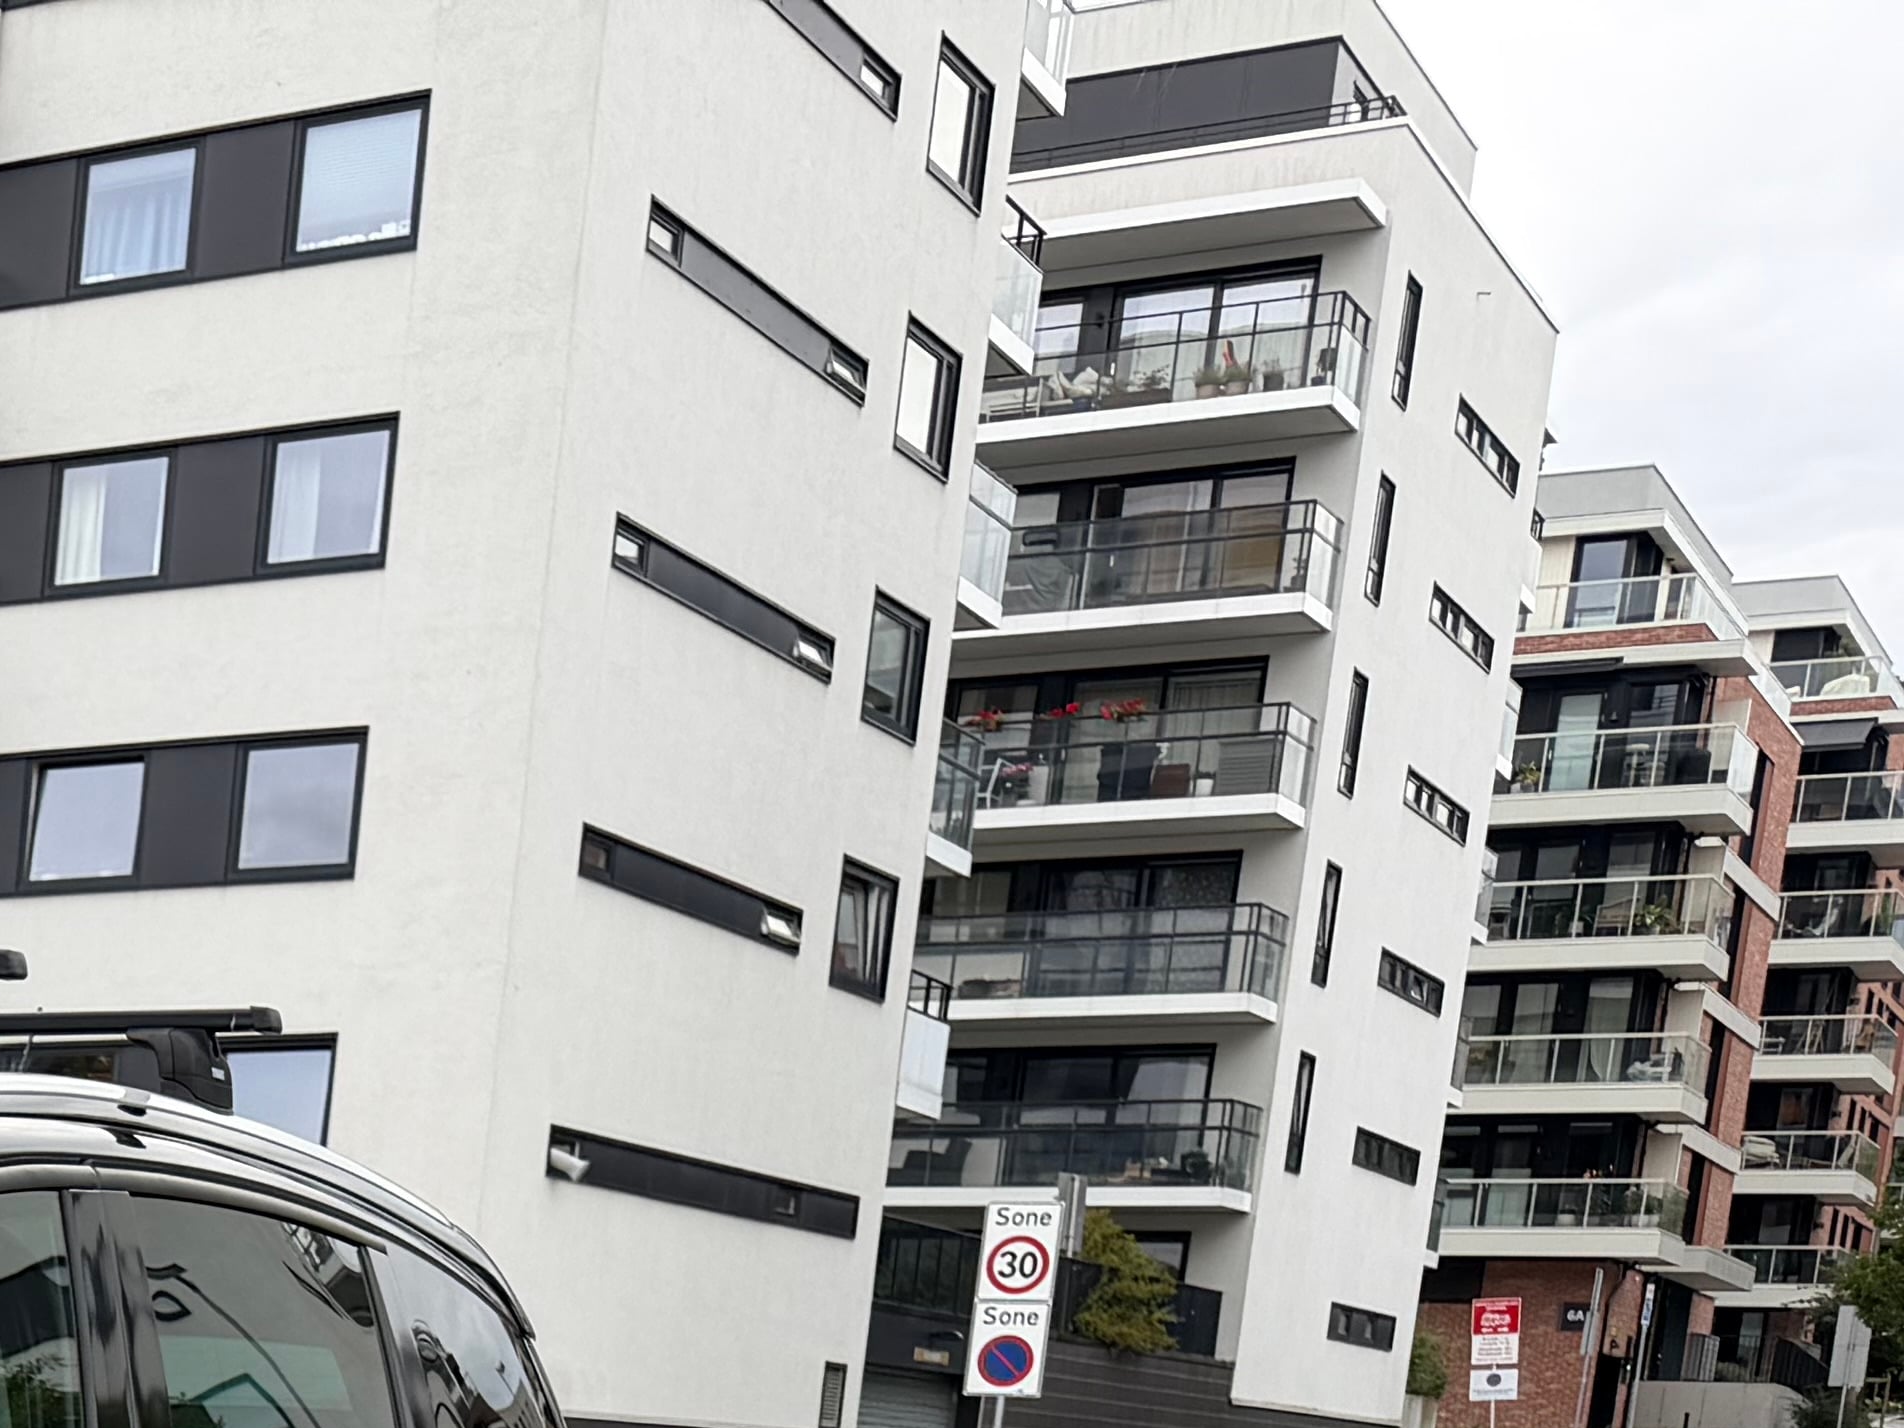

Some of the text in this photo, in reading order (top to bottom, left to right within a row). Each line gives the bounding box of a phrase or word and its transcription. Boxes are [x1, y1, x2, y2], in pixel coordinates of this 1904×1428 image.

[995, 1207, 1052, 1226] Sone
[997, 1251, 1038, 1279] 30
[983, 1307, 1039, 1326] Sone
